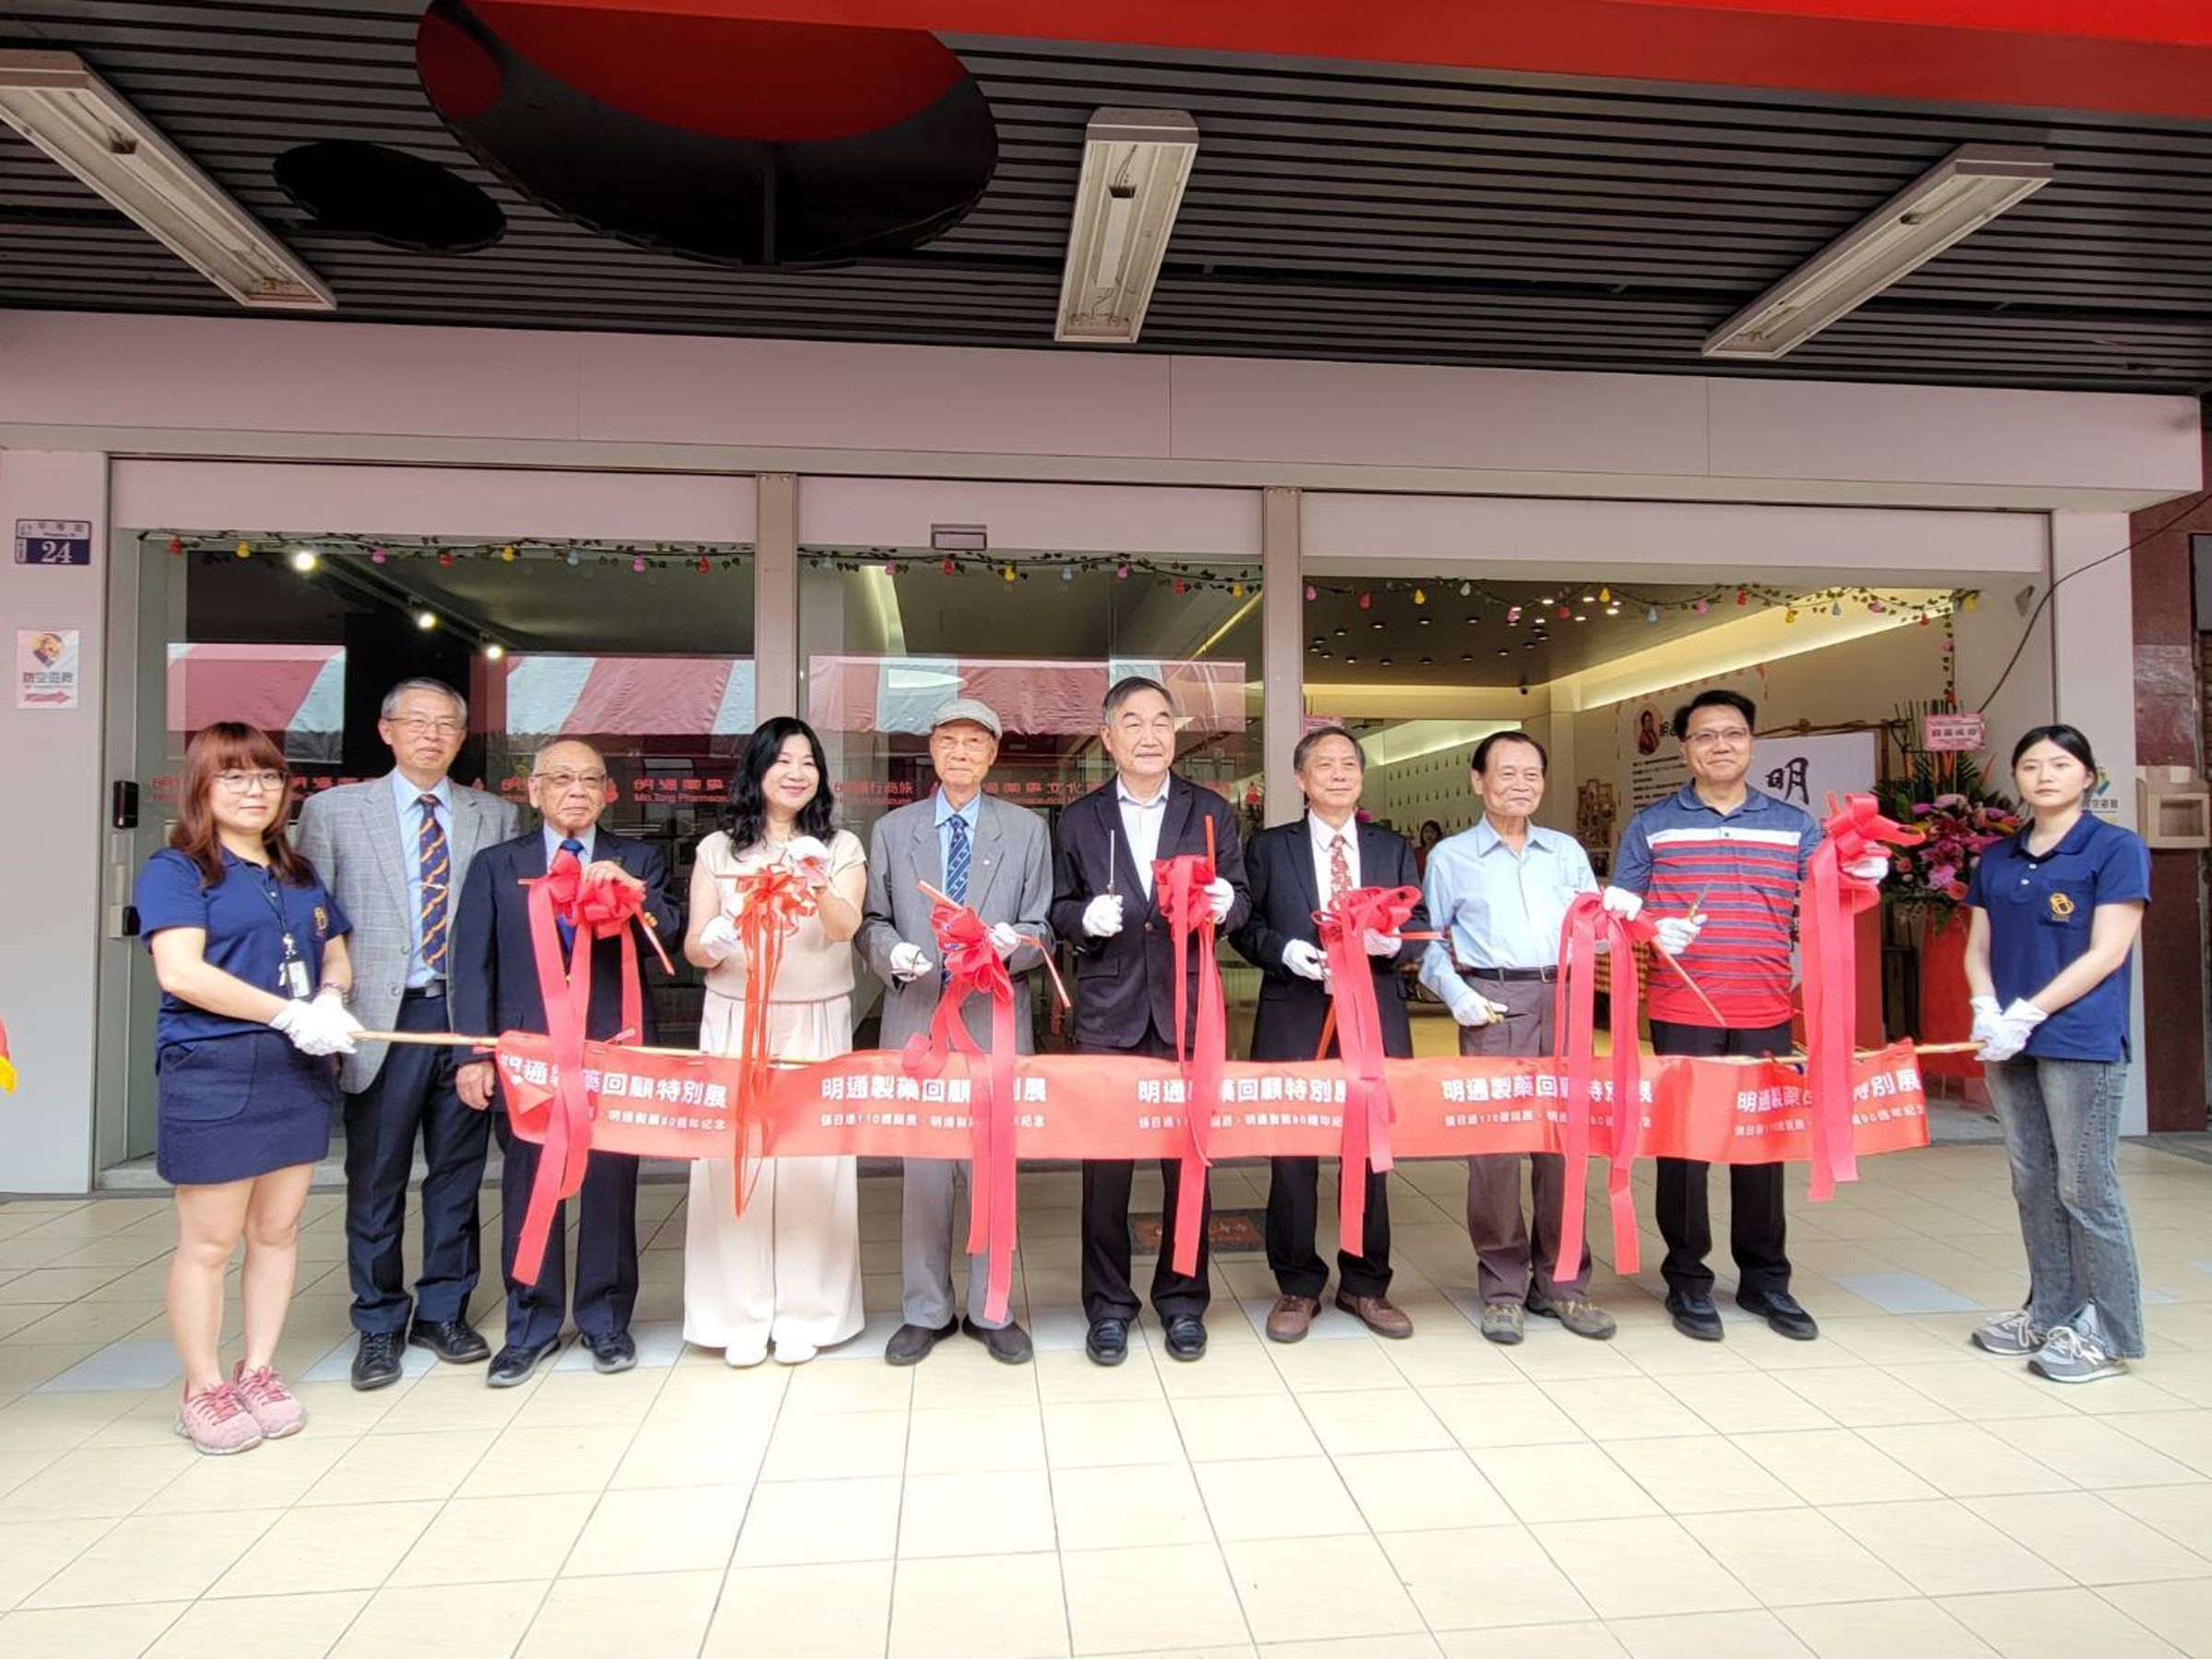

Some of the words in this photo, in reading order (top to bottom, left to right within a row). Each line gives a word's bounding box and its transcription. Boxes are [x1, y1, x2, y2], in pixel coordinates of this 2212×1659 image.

[41, 541, 72, 563] 24
[1765, 757, 1809, 806] 明
[821, 1075, 1047, 1101] 明通製藥回顧展
[1137, 1077, 1347, 1104] 明通藥回顧特別展
[1736, 1068, 1924, 1113] 明通製藥回特別展
